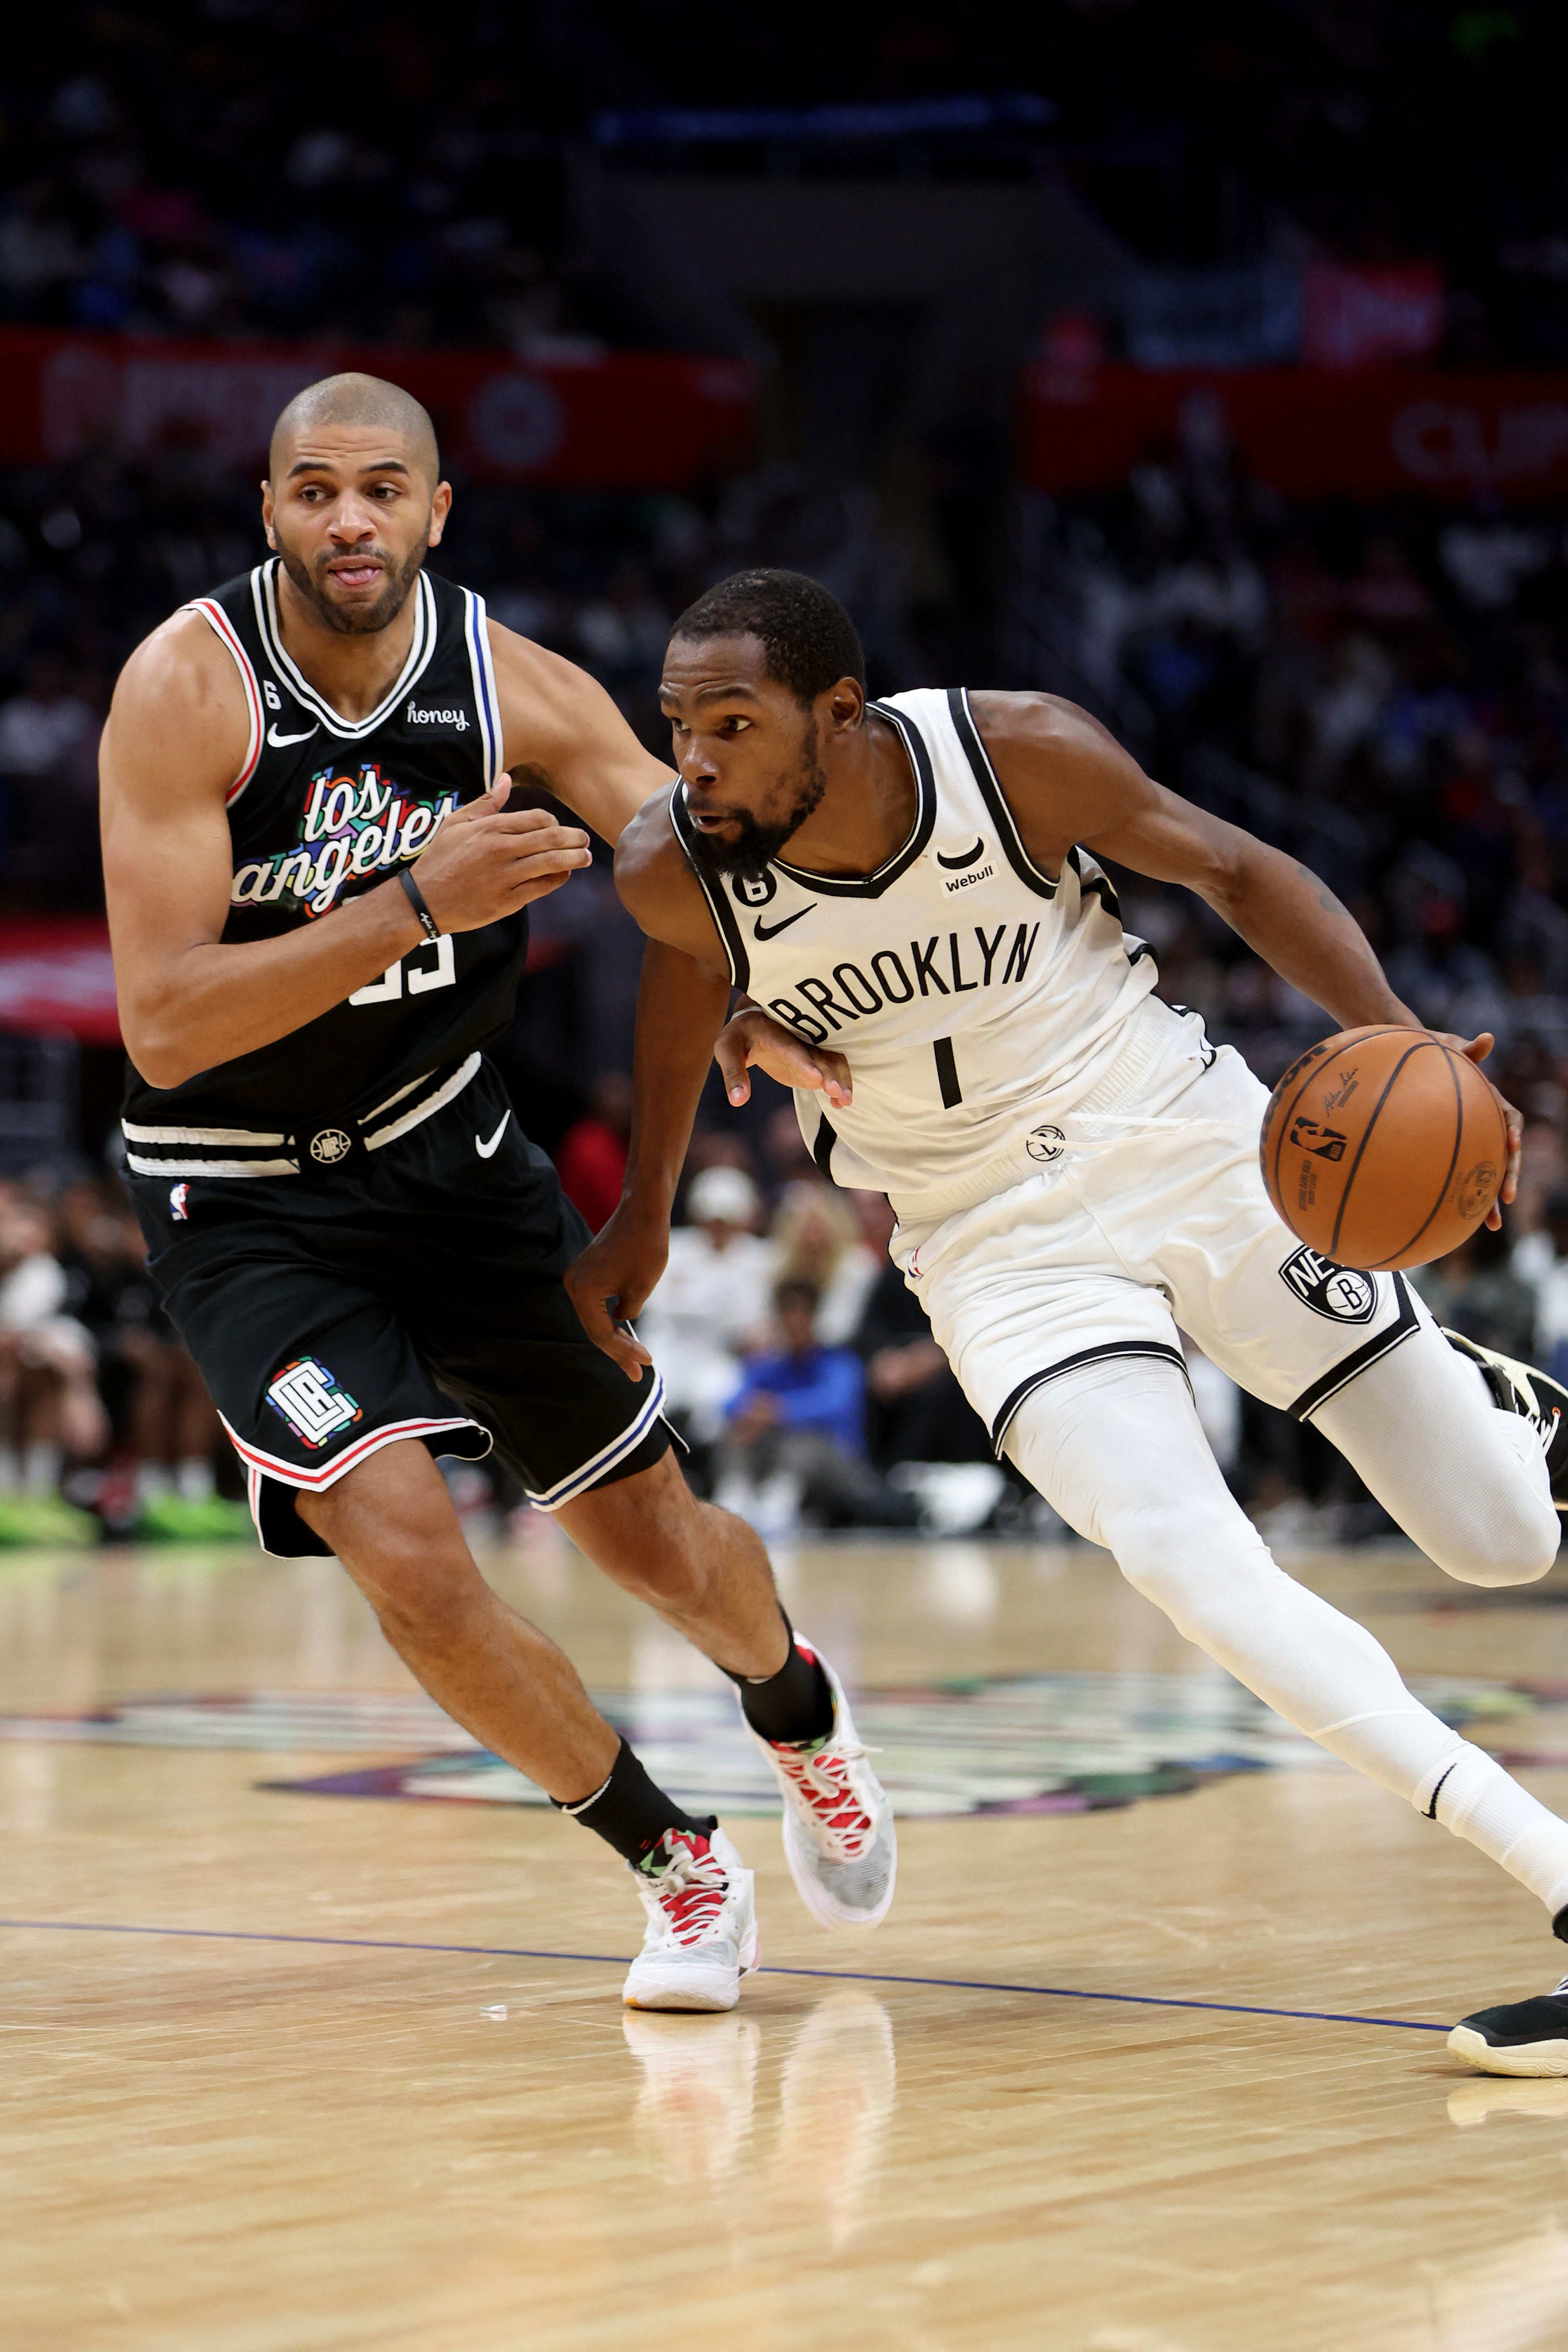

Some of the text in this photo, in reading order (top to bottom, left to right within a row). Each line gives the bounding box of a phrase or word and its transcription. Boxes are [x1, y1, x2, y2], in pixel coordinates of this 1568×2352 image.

[263, 680, 282, 710] 6
[407, 700, 470, 731] honey
[304, 770, 393, 842] los
[945, 865, 994, 892] Webull
[767, 922, 1041, 1045] BROOKLYN
[1336, 1278, 1362, 1310] B
